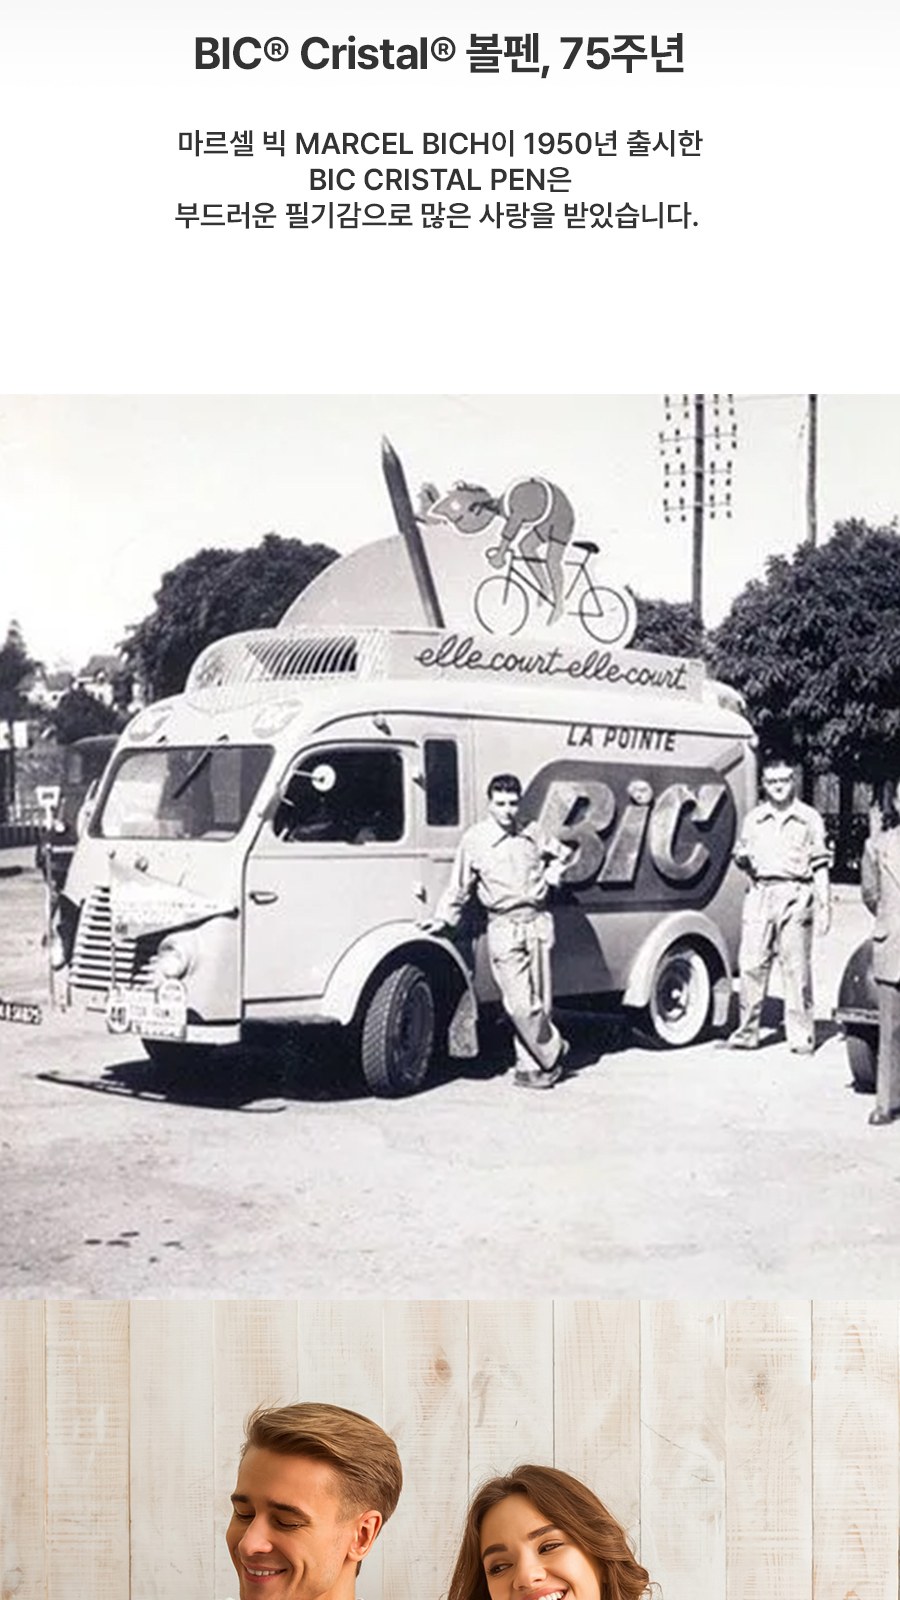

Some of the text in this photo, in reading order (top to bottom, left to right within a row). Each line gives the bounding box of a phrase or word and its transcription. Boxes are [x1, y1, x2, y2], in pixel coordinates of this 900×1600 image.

[625, 662, 687, 690] court
[567, 726, 676, 751] LA POINTE
